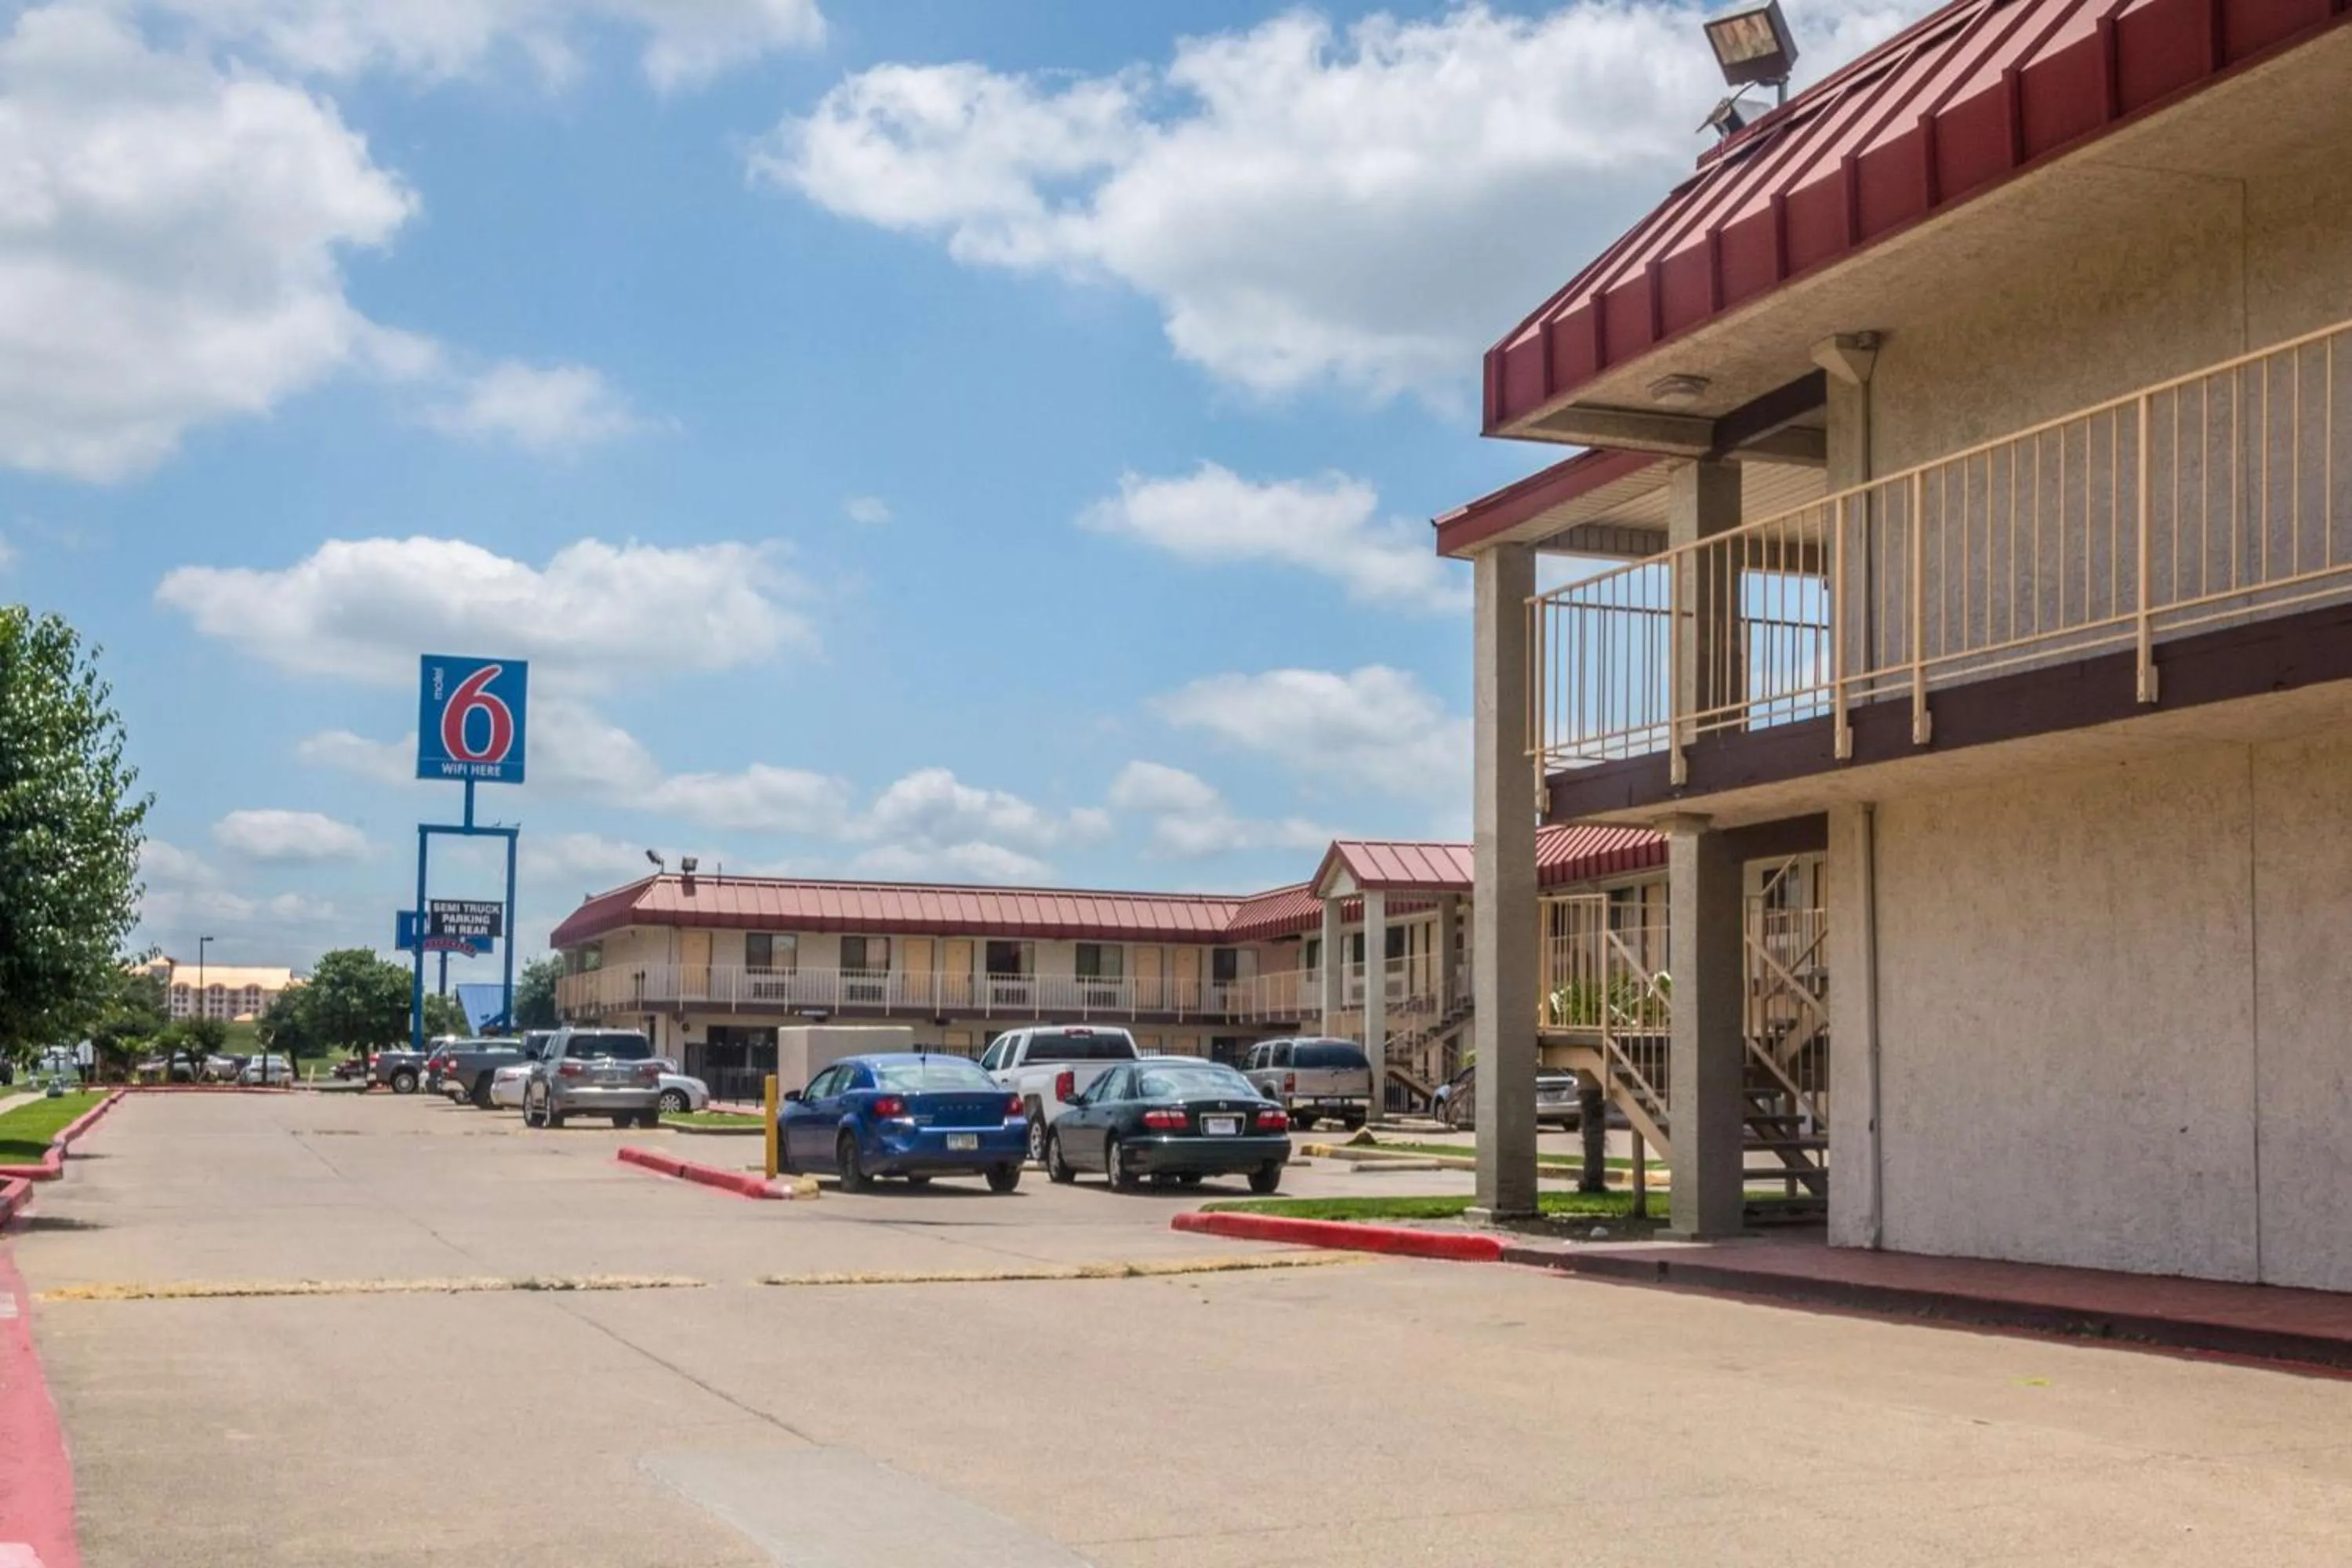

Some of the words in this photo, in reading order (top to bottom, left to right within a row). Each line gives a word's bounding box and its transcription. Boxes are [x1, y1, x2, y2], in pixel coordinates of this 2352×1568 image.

[441, 664, 514, 762] 6
[441, 762, 468, 775] WIFI
[471, 764, 502, 777] HERE
[433, 902, 460, 913] SEMI
[463, 903, 500, 915] TRUCK
[441, 913, 490, 924] PARKING
[443, 924, 456, 935] IN
[459, 925, 488, 935] REAR
